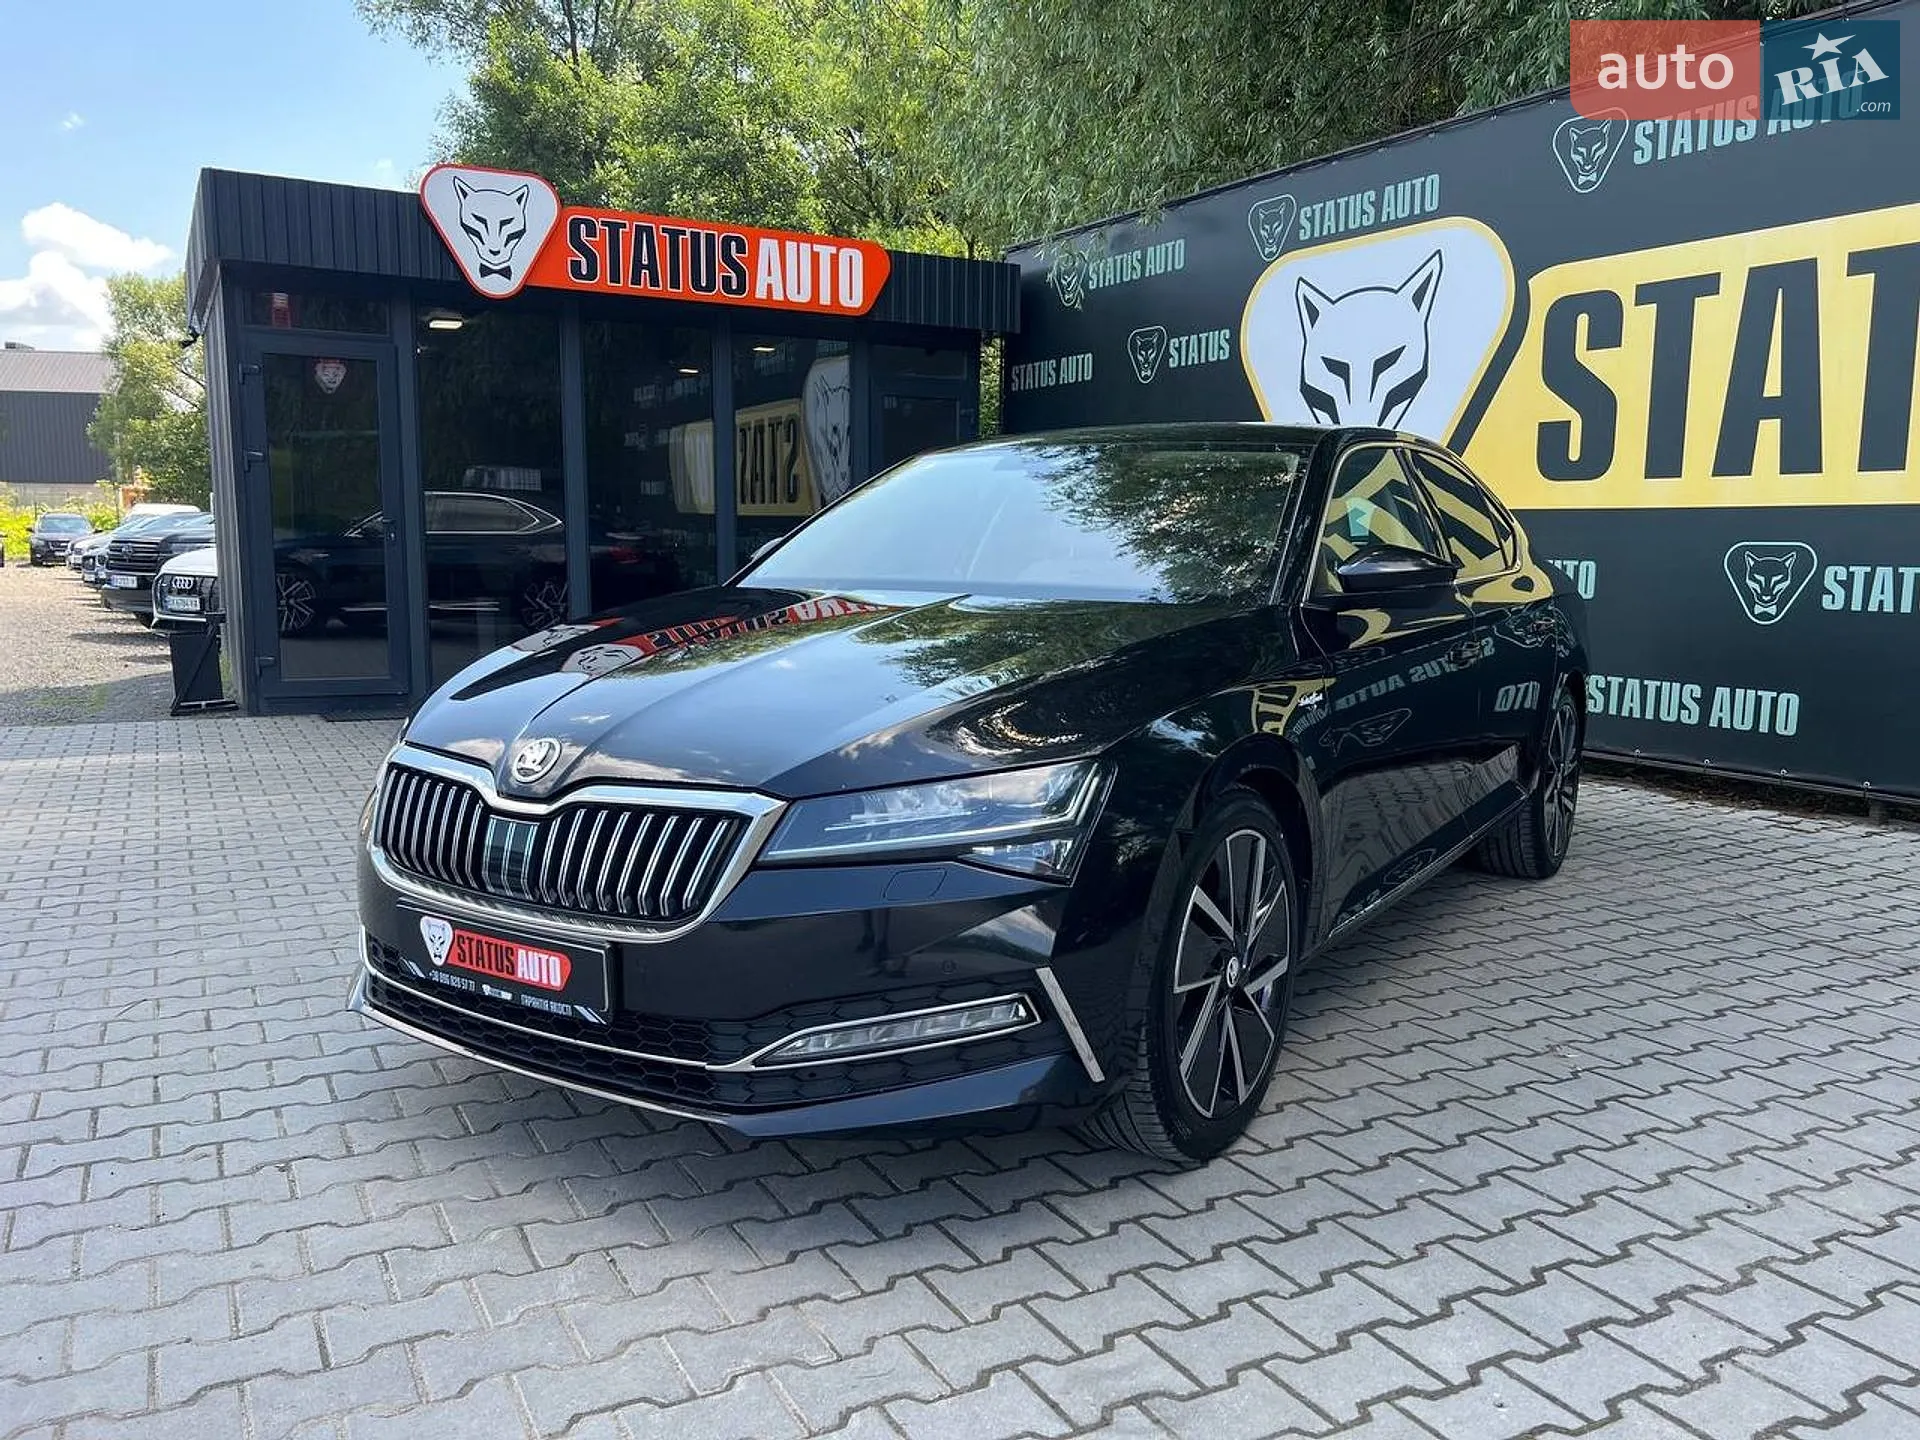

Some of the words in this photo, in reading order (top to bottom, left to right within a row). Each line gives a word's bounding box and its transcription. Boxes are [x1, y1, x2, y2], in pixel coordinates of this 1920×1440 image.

[1633, 95, 1757, 166] STATUS
[1299, 190, 1377, 241] STATUS
[1381, 173, 1440, 222] AUTO
[567, 215, 749, 298] STATUS
[755, 238, 863, 308] AUTO
[1088, 250, 1142, 290] STATUS
[1145, 238, 1185, 277] AUTO
[1012, 359, 1056, 392] STATUS
[1059, 353, 1093, 384] AUTO
[1168, 328, 1230, 368] STATUS
[1587, 674, 1701, 725] STATUS
[1708, 686, 1800, 737] AUTO
[456, 935, 515, 976] STATUS
[517, 948, 562, 988] AUTO
